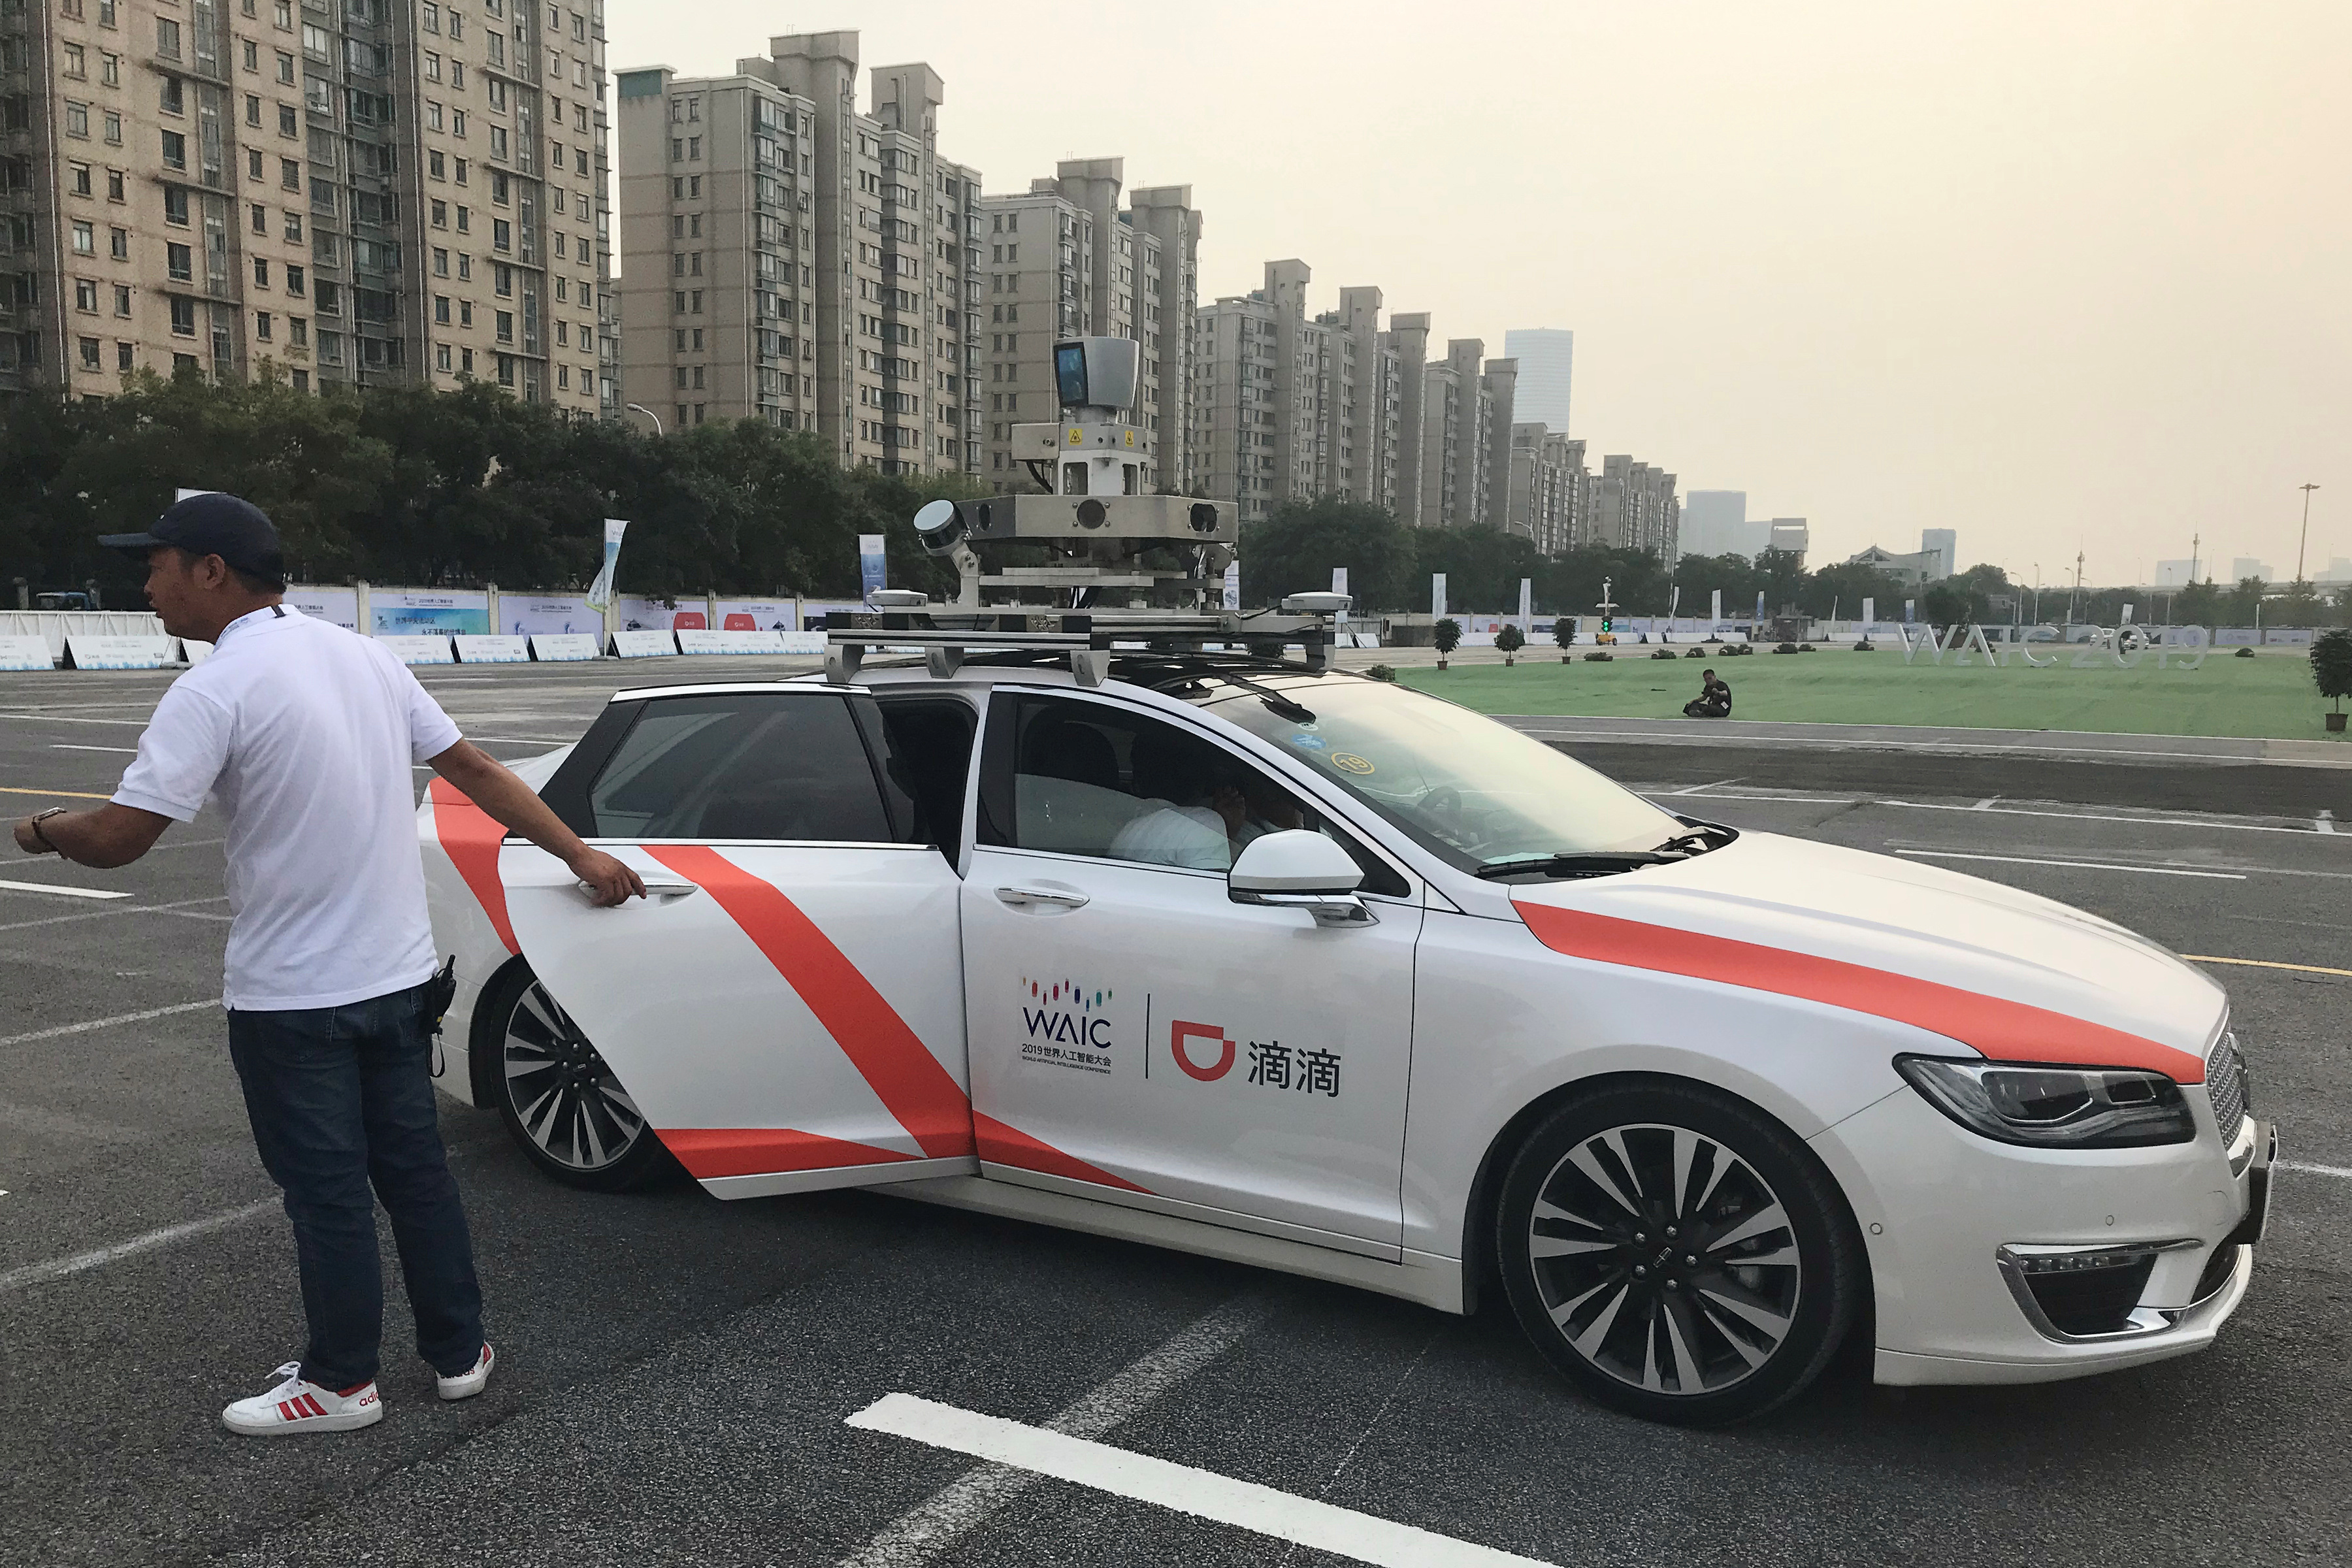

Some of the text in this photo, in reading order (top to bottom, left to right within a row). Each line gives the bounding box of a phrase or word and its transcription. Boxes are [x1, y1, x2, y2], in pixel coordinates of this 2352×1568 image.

[1895, 624, 2209, 670] WAIC 2019
[1339, 757, 1368, 770] 19
[1022, 1007, 1112, 1049] WAIC
[1248, 1040, 1341, 1098] 滴滴
